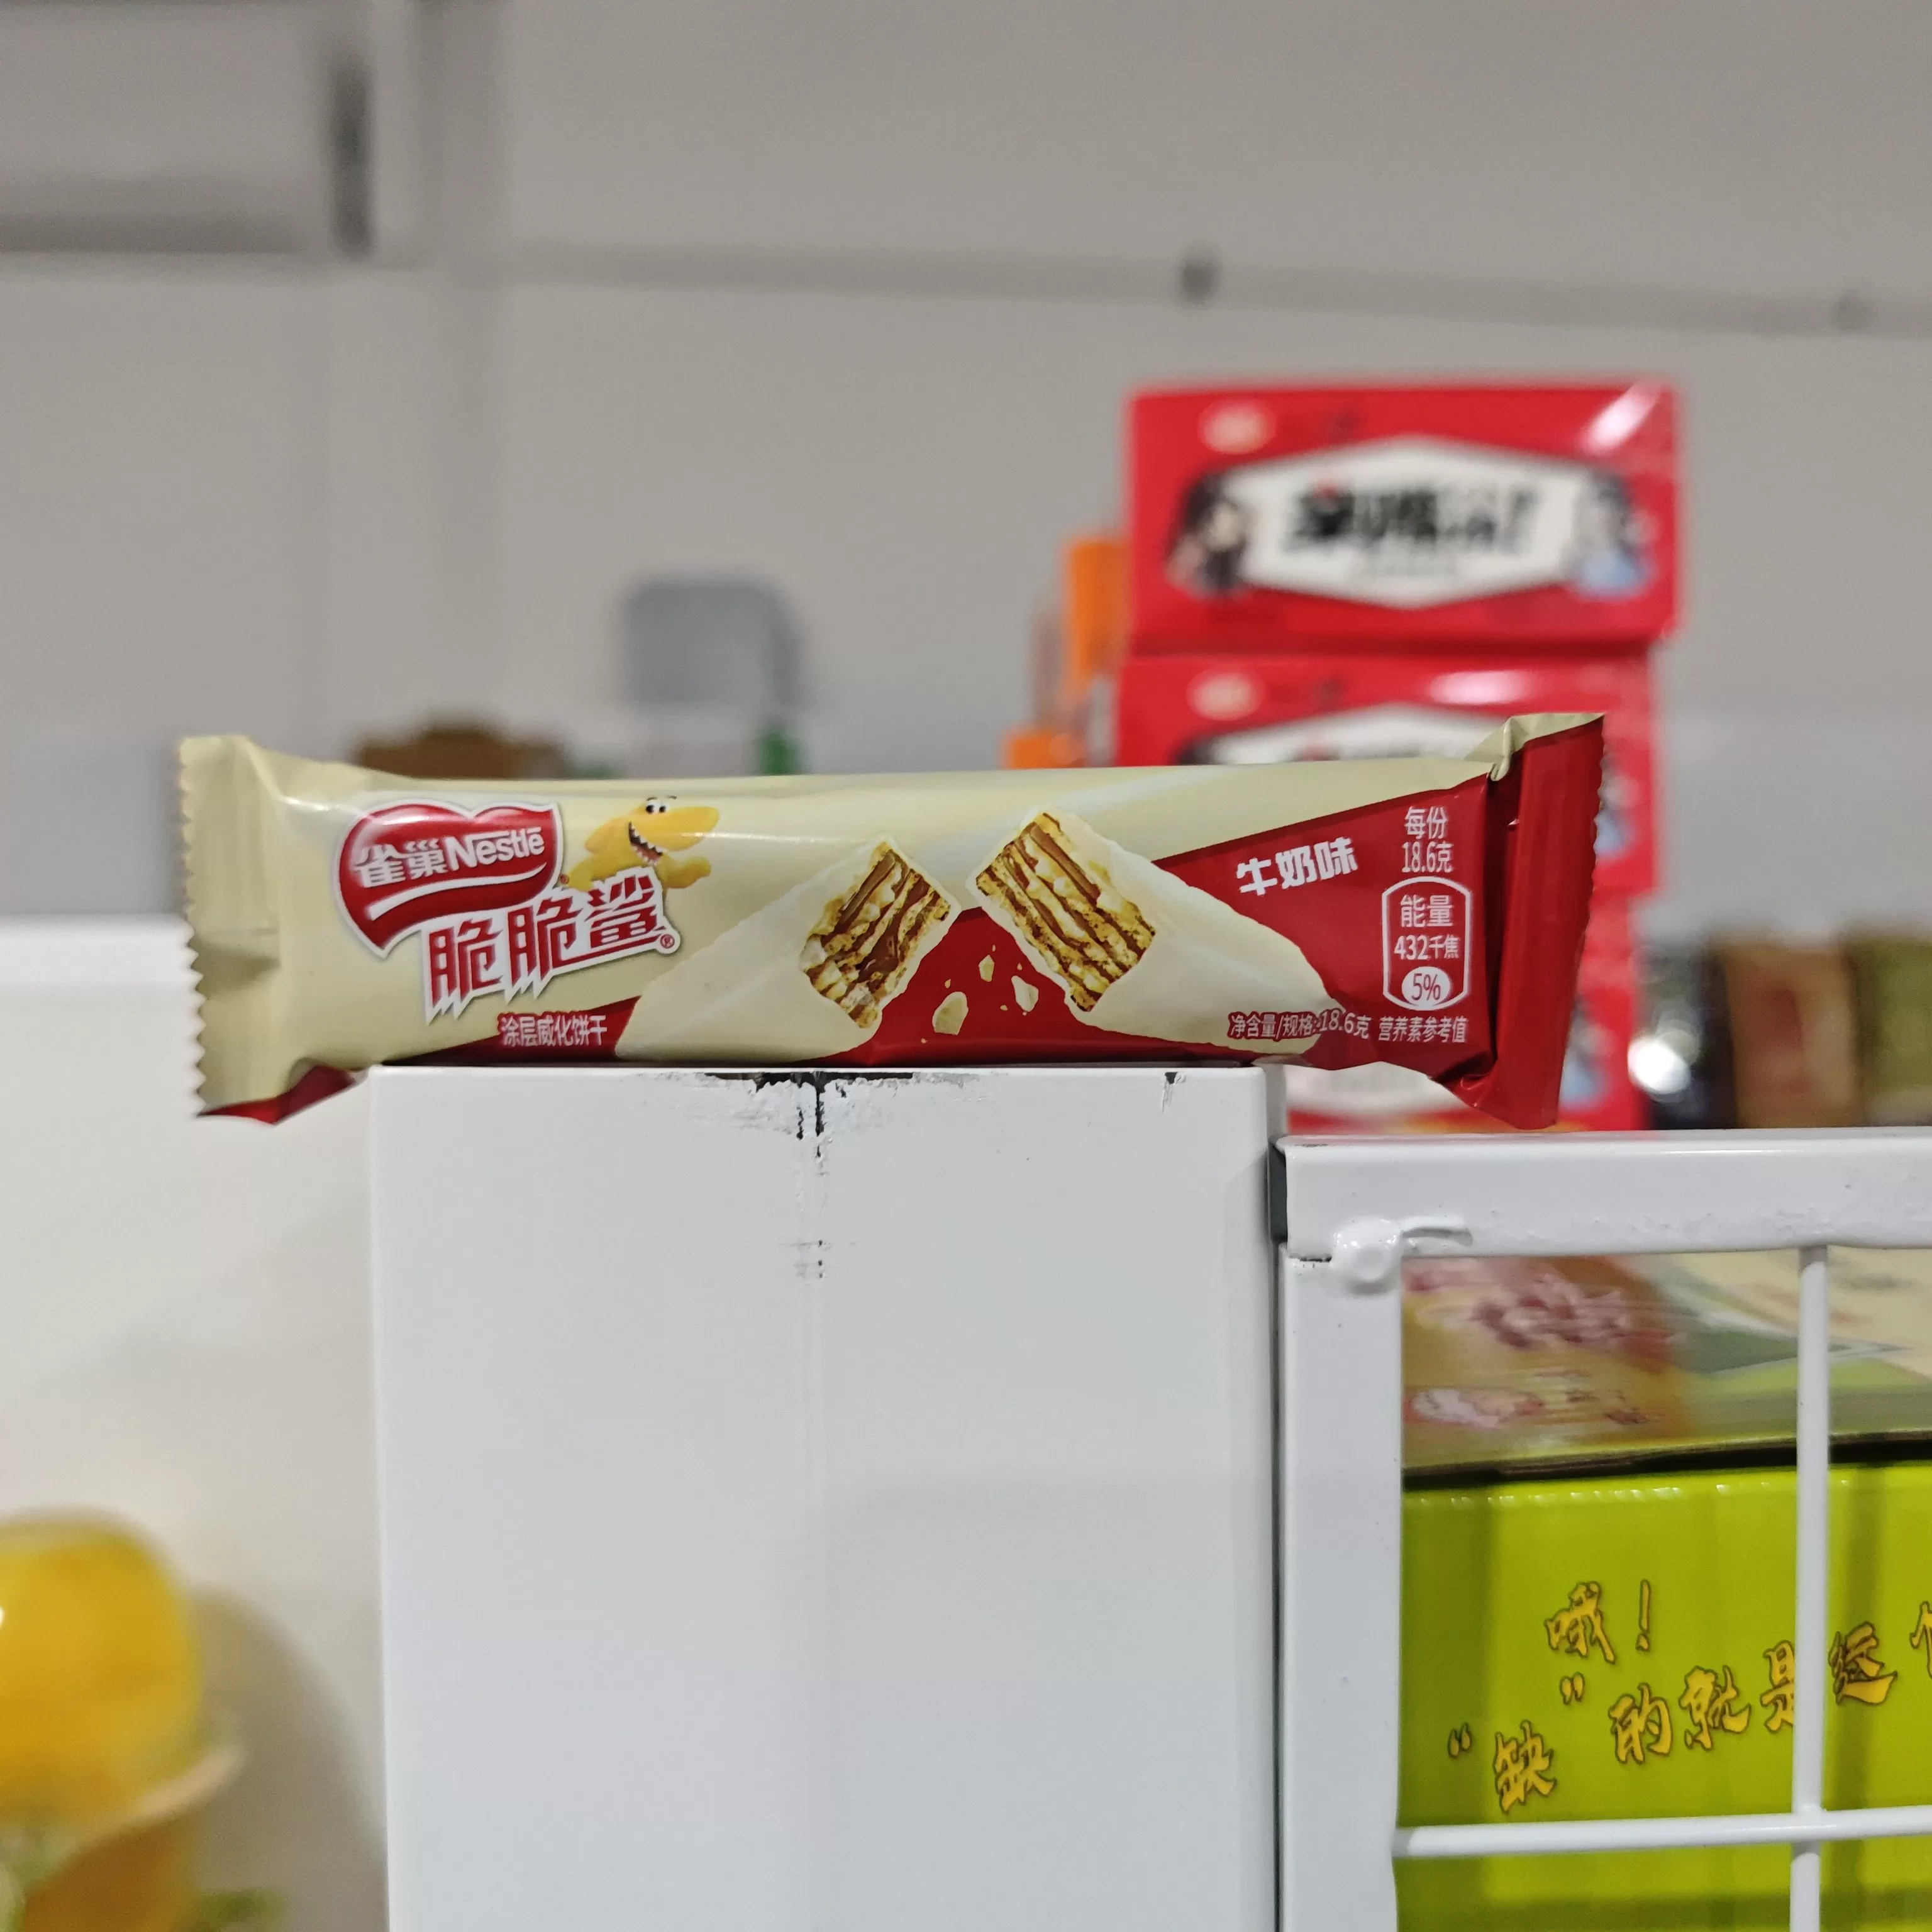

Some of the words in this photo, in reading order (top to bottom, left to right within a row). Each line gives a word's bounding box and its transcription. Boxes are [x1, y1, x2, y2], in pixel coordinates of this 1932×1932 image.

[1405, 806, 1446, 840] 每份
[1236, 836, 1358, 896] 牛奶味
[1401, 841, 1454, 873] 18.6克
[1400, 894, 1453, 928] 能量
[428, 874, 665, 1008] 脆脆鲨
[1394, 934, 1460, 960] 432千焦
[1411, 973, 1441, 1001] 5%
[501, 1014, 608, 1047] 涂层威化饼干
[1378, 1016, 1468, 1043] 营养素参考值
